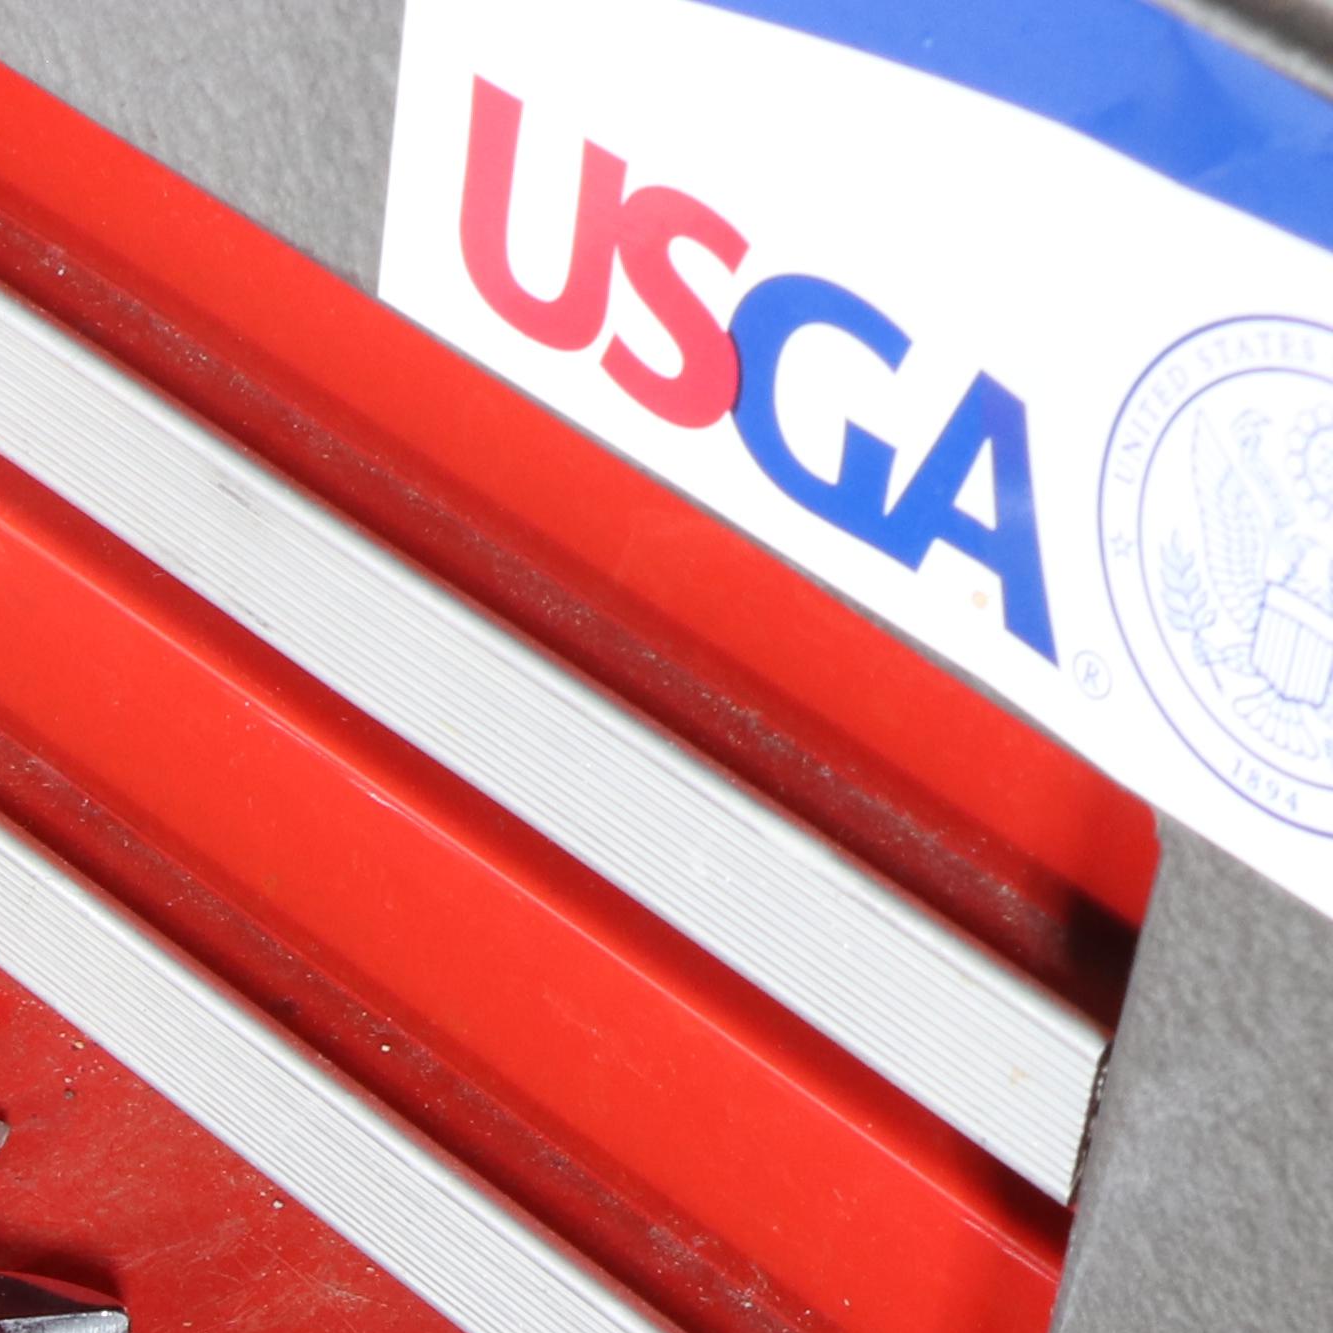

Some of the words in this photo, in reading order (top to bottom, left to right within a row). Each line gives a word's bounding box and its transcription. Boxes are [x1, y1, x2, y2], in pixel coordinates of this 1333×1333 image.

[459, 74, 1059, 670] USGA
[1114, 362, 1190, 485] UNITED
[1195, 330, 1316, 373] STATES
[1231, 756, 1301, 814] 1894
